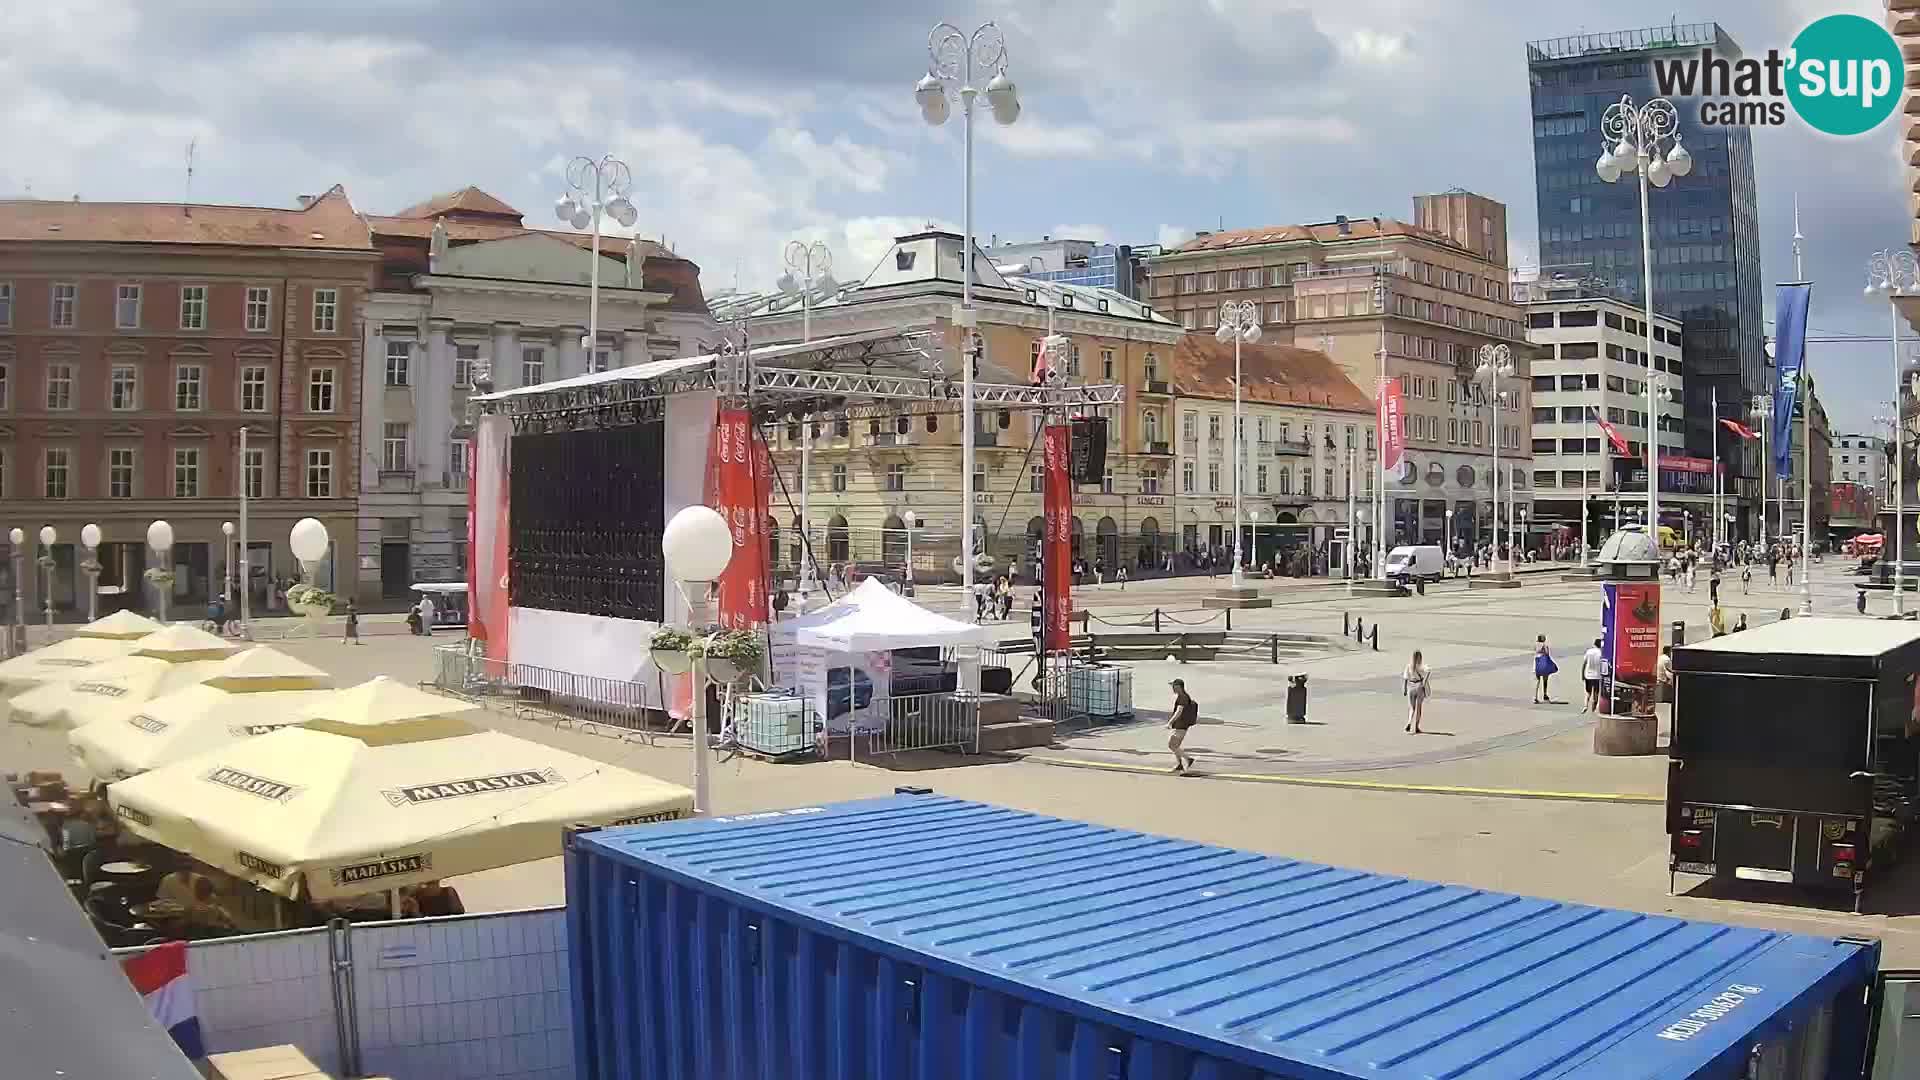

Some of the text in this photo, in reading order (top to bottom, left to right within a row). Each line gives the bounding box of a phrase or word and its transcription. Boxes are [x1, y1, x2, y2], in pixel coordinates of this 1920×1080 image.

[213, 769, 291, 799] MARASKA
[411, 770, 544, 802] MARASKA
[343, 857, 420, 881] MARASKA
